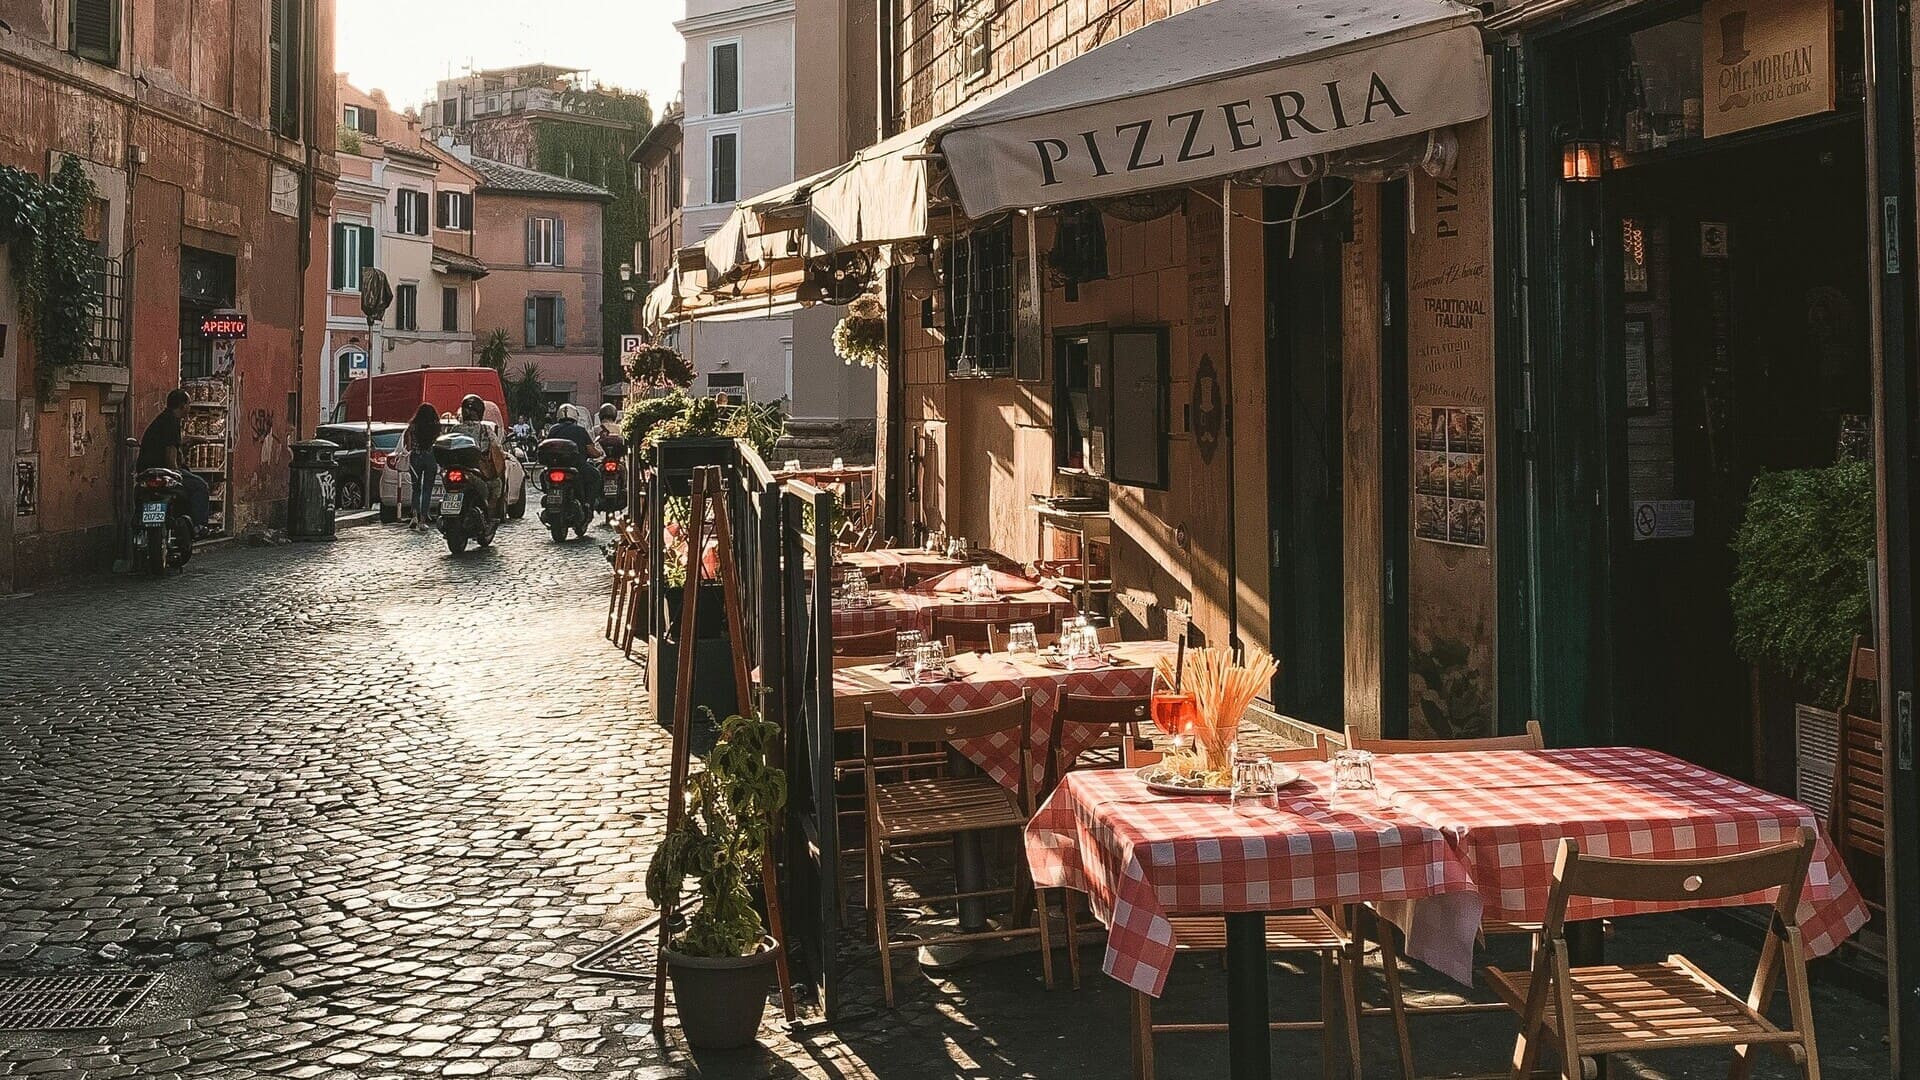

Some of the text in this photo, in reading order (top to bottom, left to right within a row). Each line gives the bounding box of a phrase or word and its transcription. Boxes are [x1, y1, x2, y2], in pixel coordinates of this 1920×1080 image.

[1752, 77, 1812, 105] food & drink
[1028, 71, 1411, 187] PIZZERIA
[1436, 163, 1459, 239] PIZ
[1423, 297, 1486, 315] TRADITIONAL
[203, 321, 245, 333] APERTO
[1435, 313, 1473, 329] ITALIAN
[626, 339, 637, 352] P
[1441, 336, 1470, 353] virgin
[353, 353, 365, 368] P
